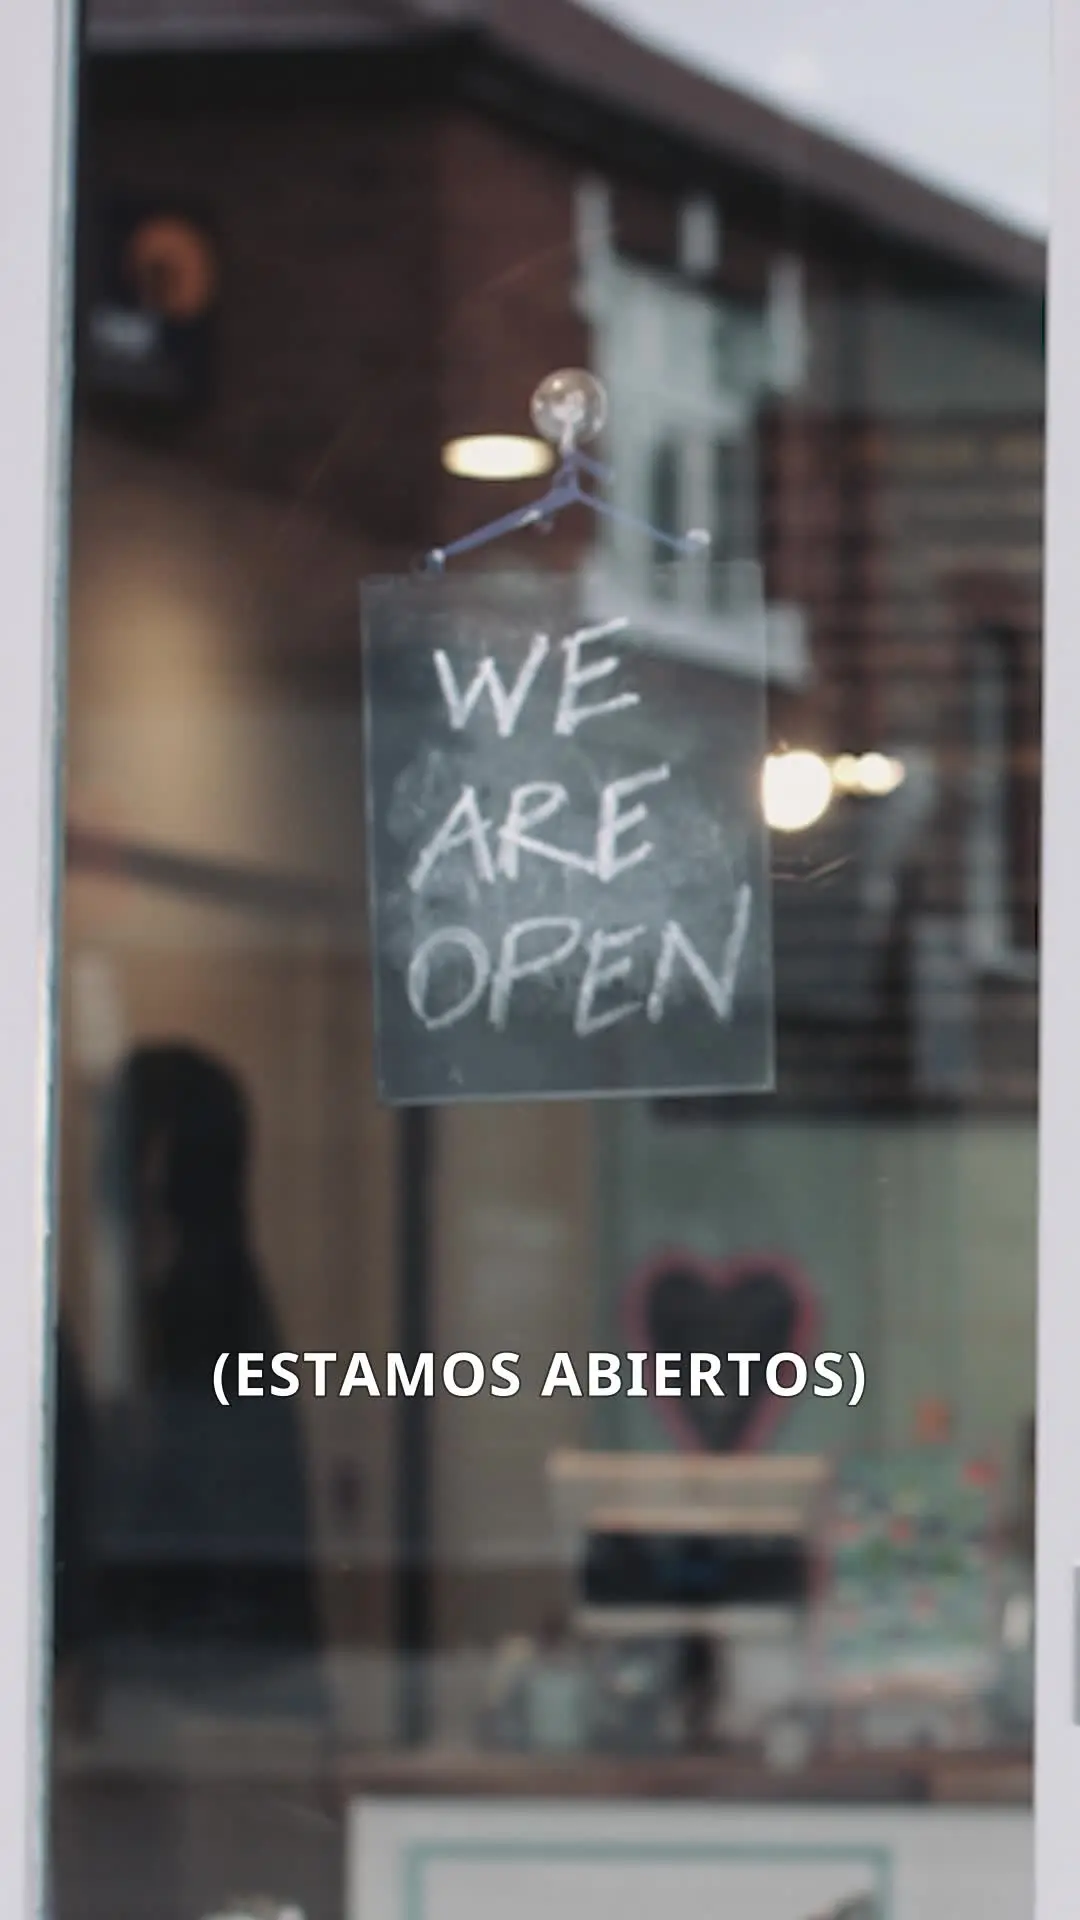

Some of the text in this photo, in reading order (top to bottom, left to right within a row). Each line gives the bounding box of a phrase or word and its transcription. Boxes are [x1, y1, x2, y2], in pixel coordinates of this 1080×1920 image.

[433, 617, 641, 737] WE
[408, 763, 670, 892] ARE
[408, 884, 752, 1038] OPEN
